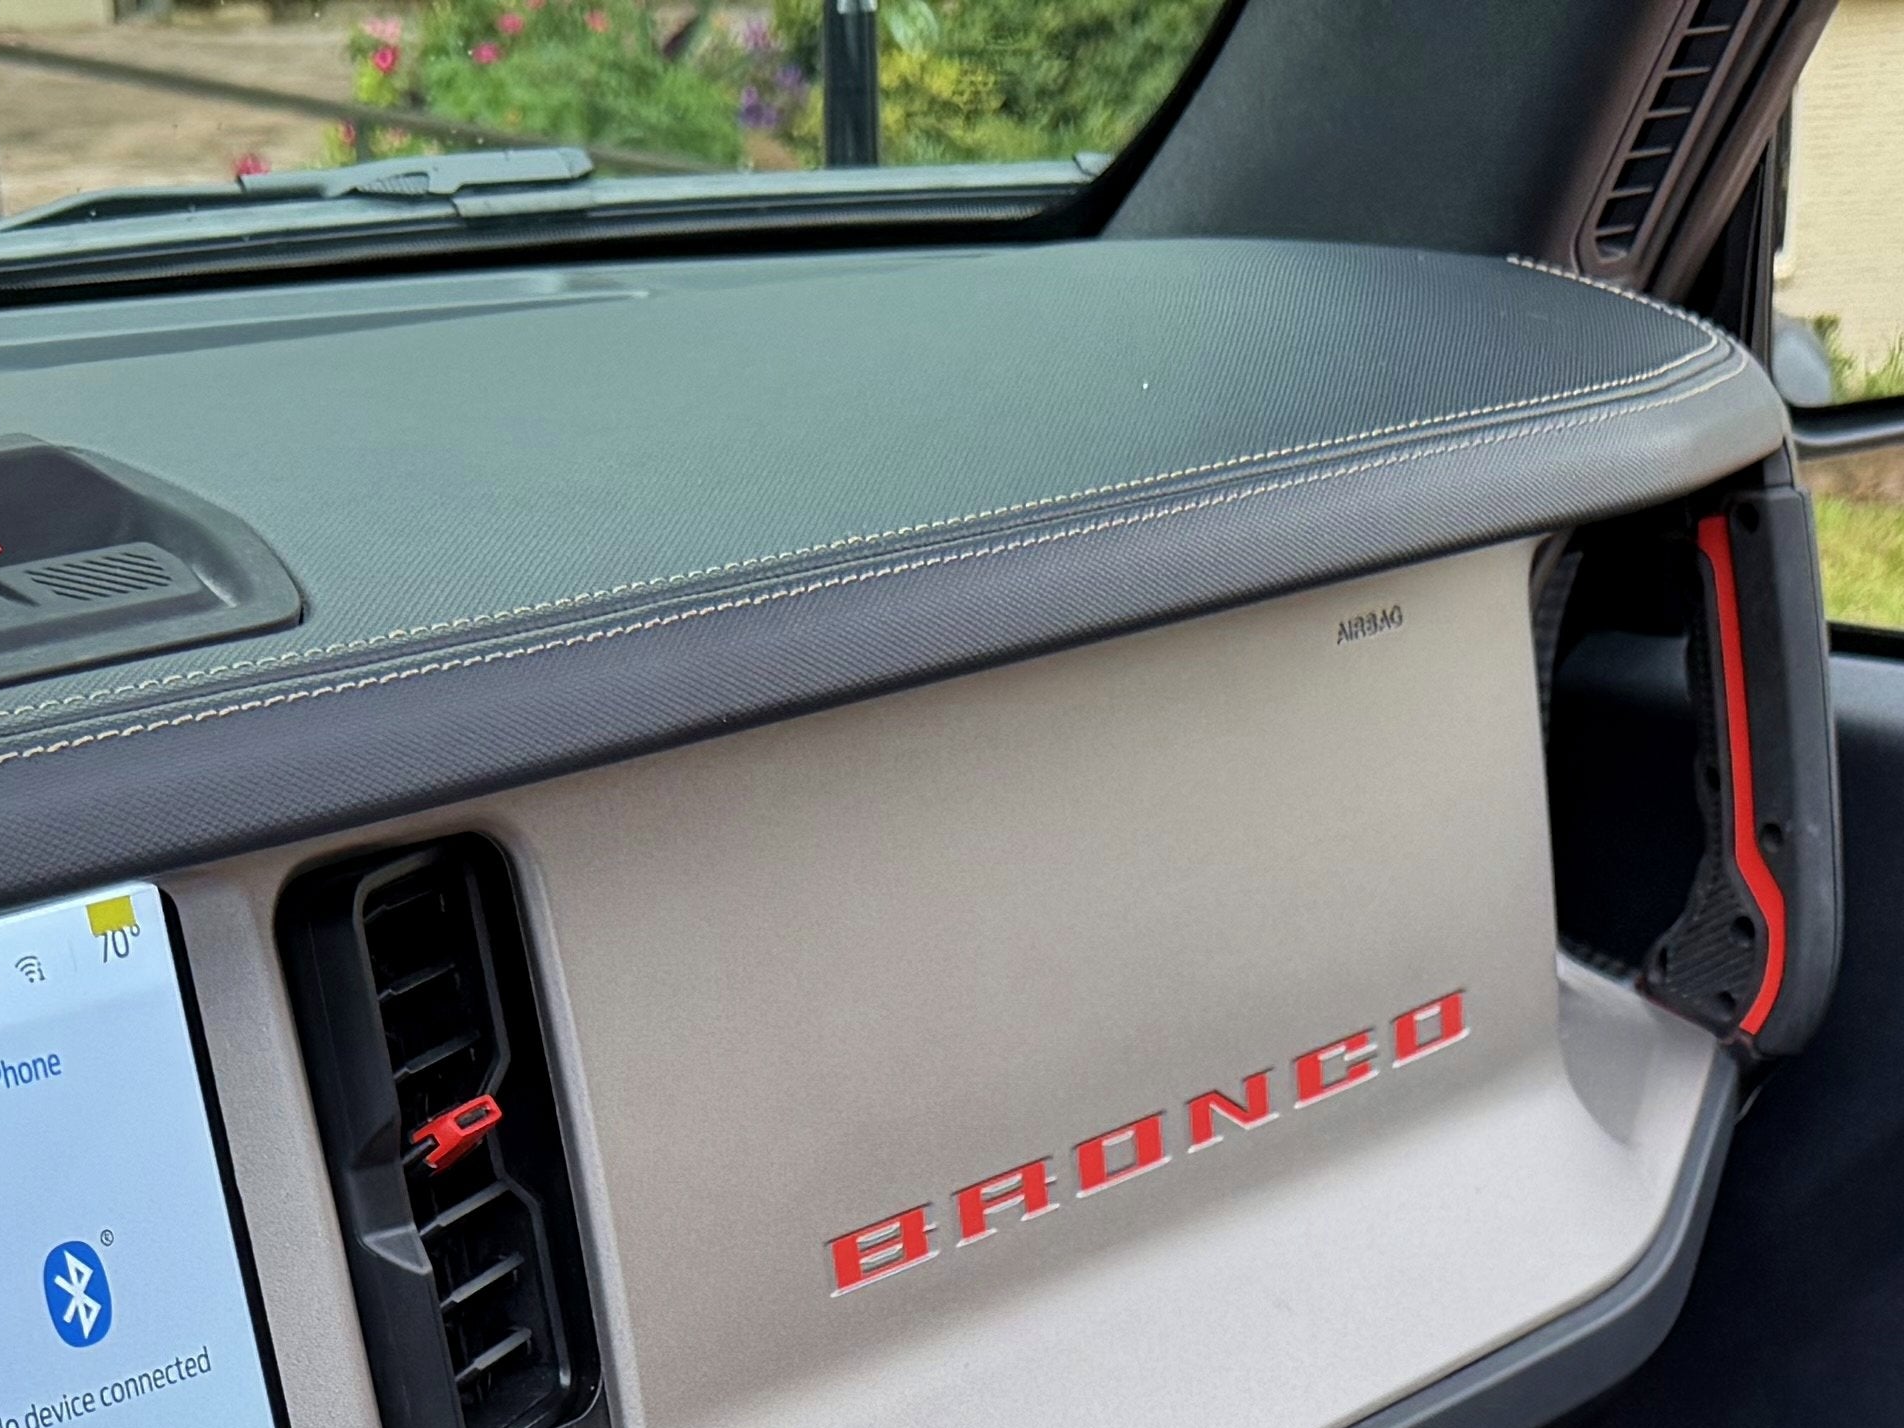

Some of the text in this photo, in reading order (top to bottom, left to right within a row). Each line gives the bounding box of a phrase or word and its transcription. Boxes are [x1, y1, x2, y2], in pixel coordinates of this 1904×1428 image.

[1336, 606, 1404, 646] AIRBAG
[826, 988, 1471, 1298] BRONCO
[100, 1346, 212, 1406] connected
